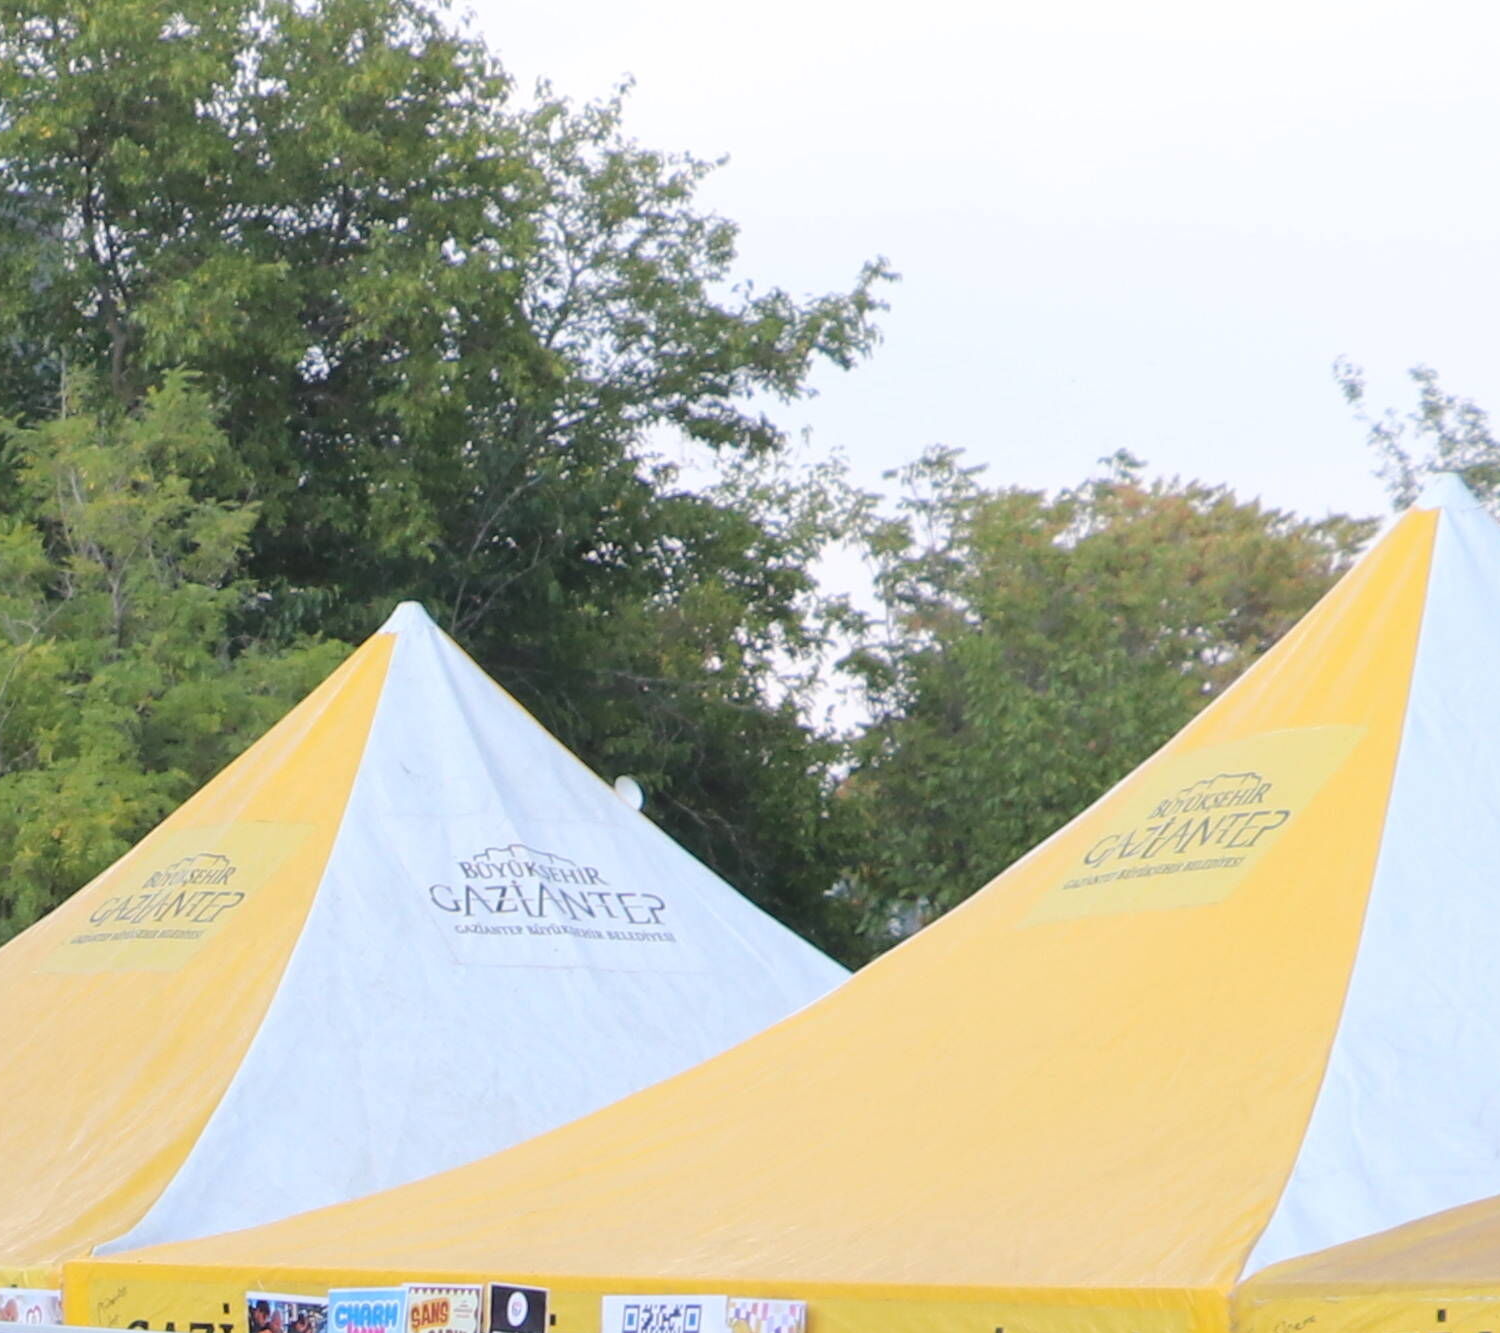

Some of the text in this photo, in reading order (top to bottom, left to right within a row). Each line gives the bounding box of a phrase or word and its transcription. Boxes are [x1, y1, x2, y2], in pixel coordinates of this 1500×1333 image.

[1084, 809, 1291, 868] GAZİANTEP
[428, 880, 667, 928] GAZİANTEP
[334, 1300, 400, 1329] CHARM
[410, 1298, 449, 1333] ŞANS
